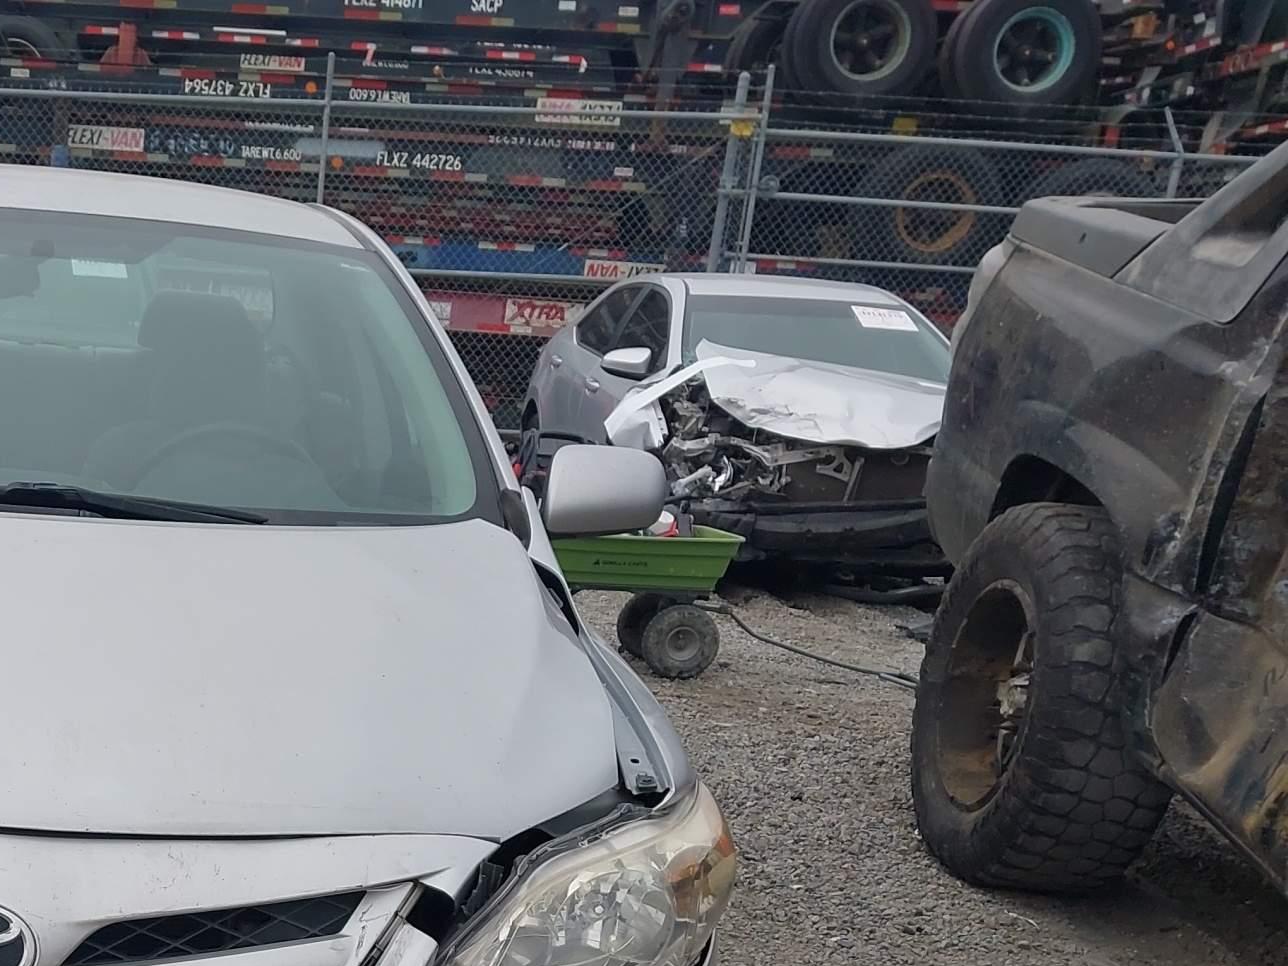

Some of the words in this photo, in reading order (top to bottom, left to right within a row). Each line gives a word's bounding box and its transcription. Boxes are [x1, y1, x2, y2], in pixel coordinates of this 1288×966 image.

[471, 0, 503, 13] SACP
[184, 77, 234, 96] 437564
[239, 81, 271, 98] FLXZ
[68, 127, 143, 149] FLEXI-VAN
[376, 151, 408, 167] FLXZ
[412, 152, 462, 171] 442726
